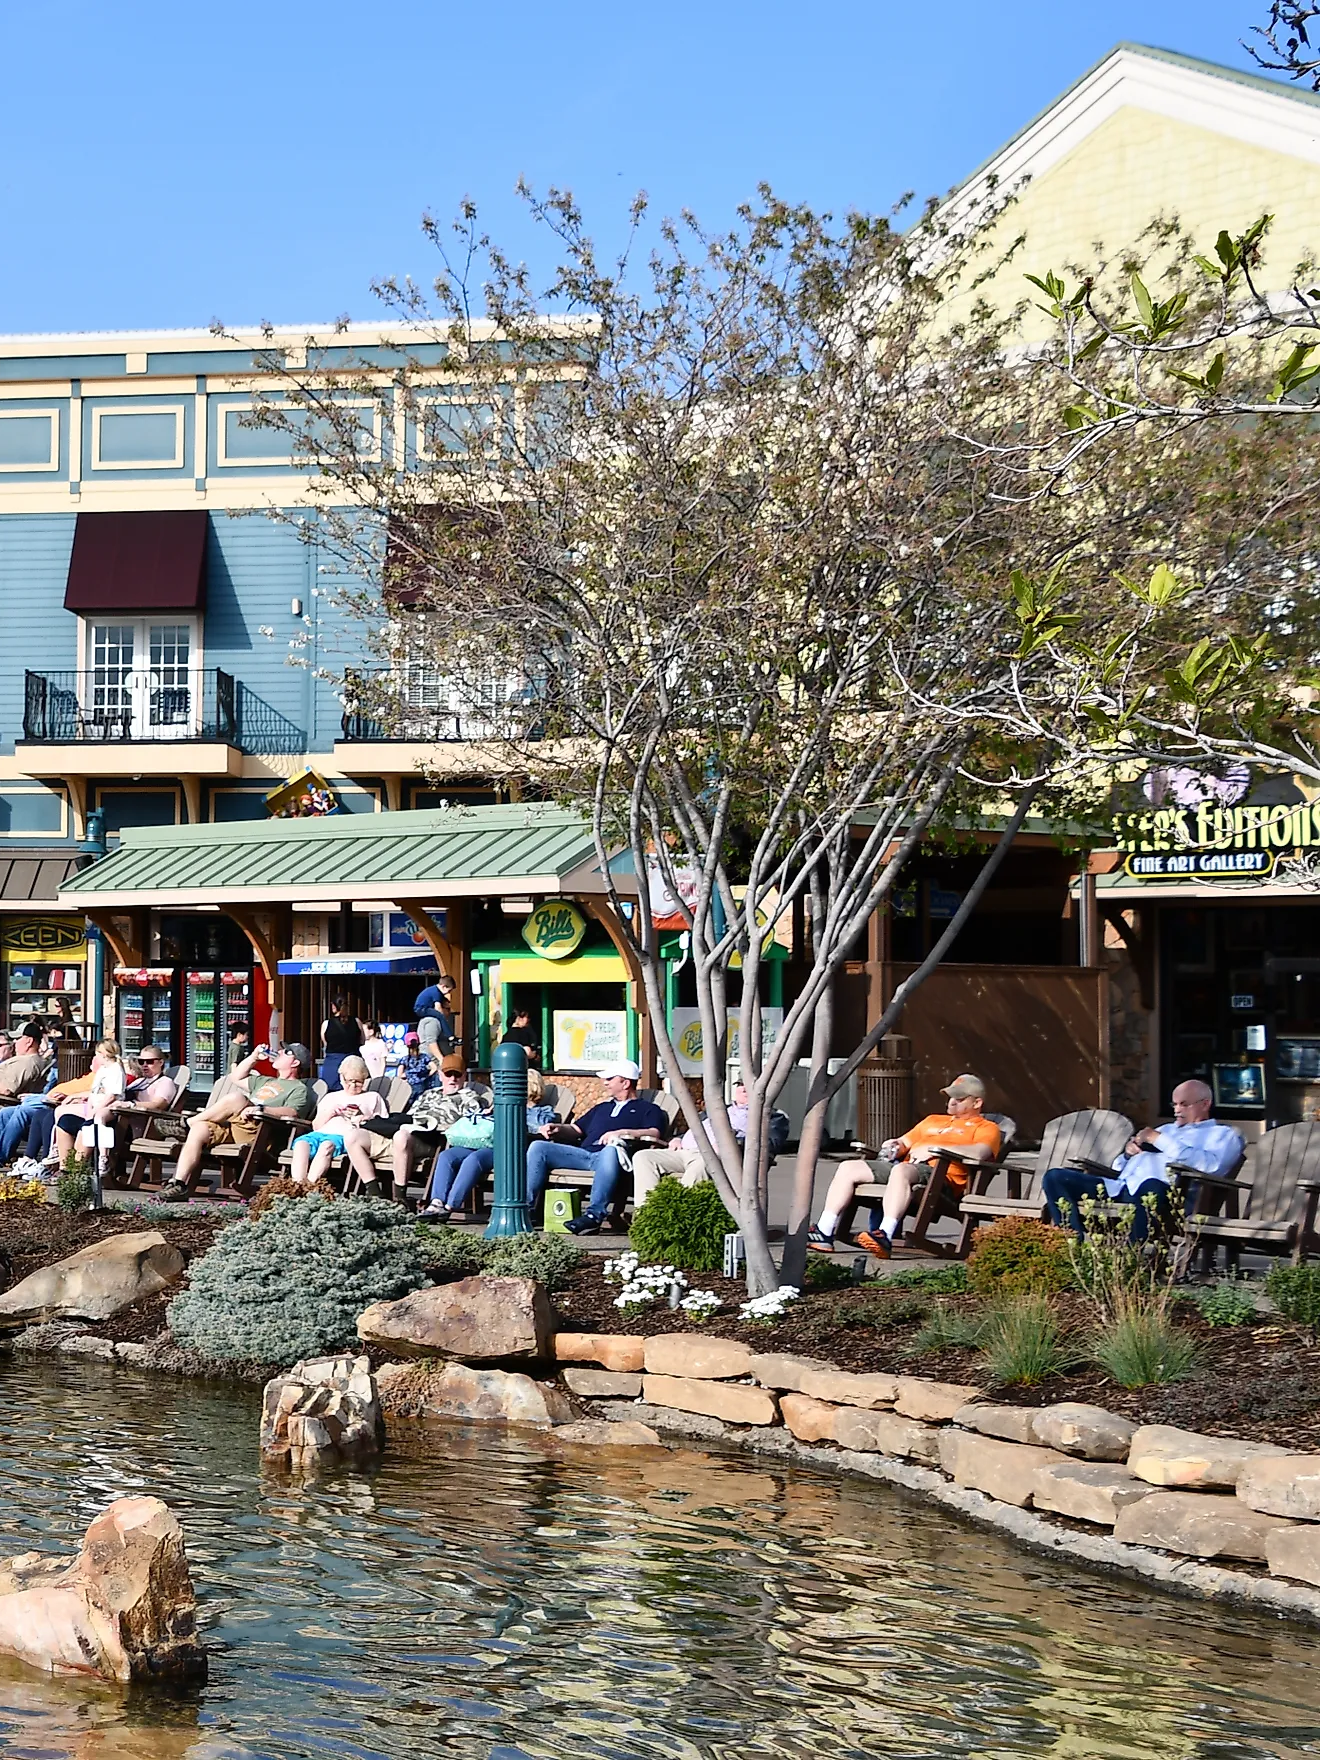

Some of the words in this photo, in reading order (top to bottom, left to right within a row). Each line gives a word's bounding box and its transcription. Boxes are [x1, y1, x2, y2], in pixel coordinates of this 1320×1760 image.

[1133, 857, 1164, 873] FINE
[1166, 855, 1195, 872] ART
[1199, 853, 1264, 871] GALLERY
[4, 925, 80, 946] KEEN
[595, 1022, 616, 1033] FRESH
[584, 1033, 621, 1048] Squeezed
[583, 1050, 619, 1061] LEMONADE
